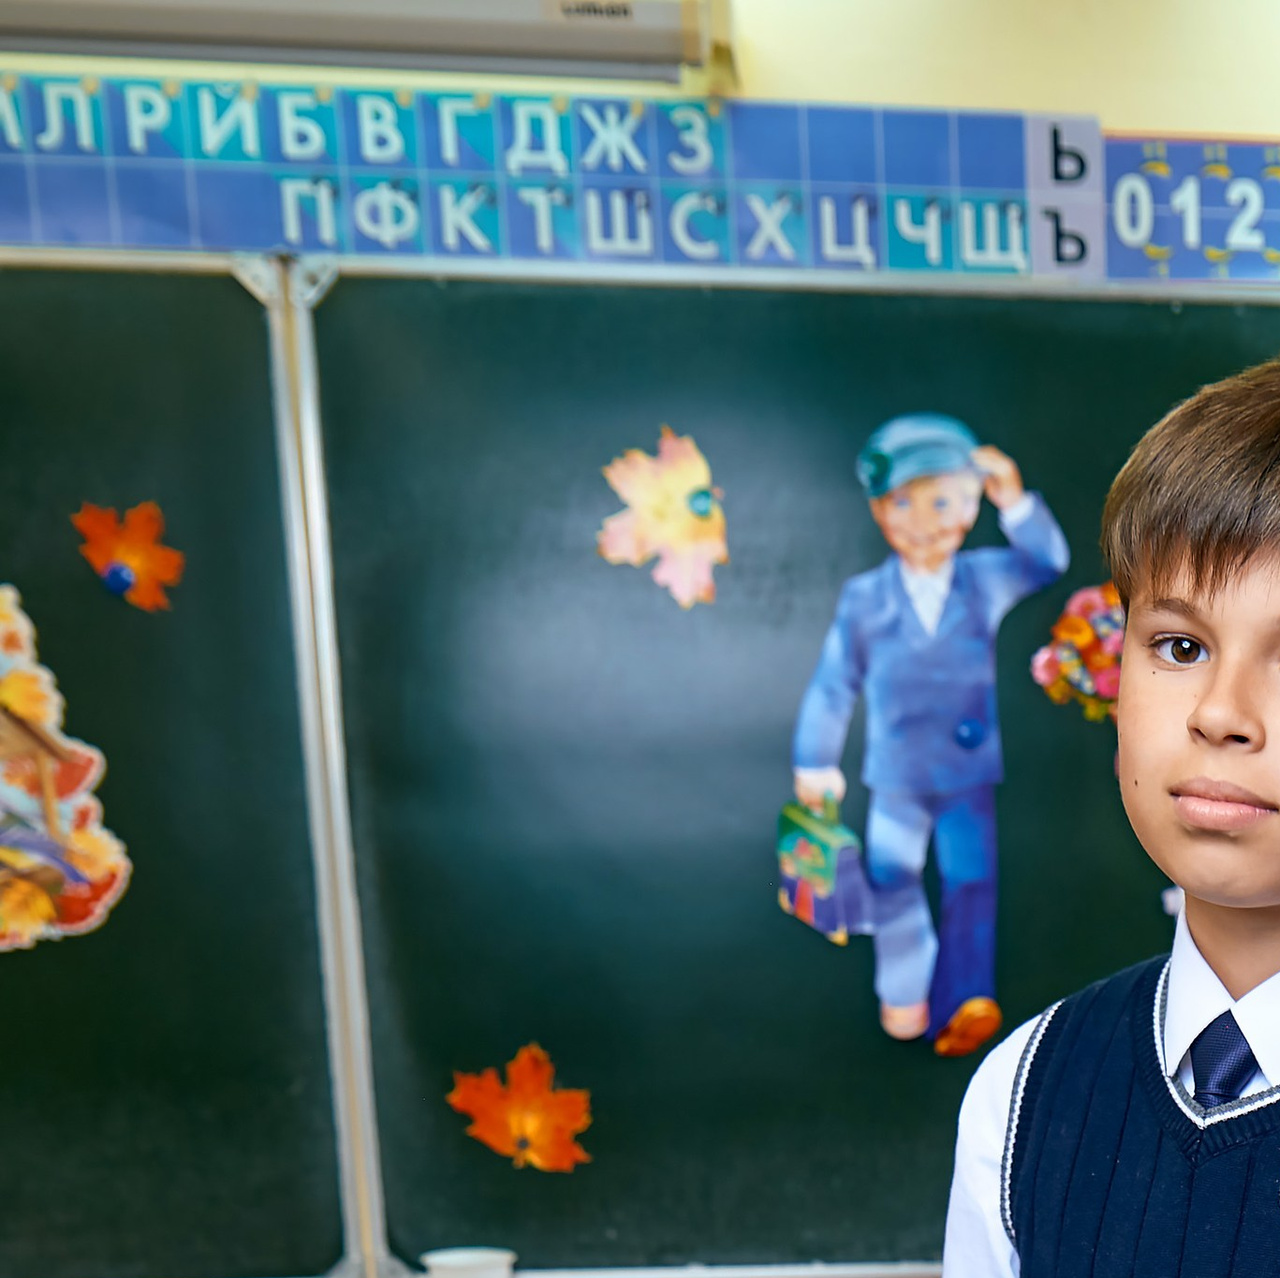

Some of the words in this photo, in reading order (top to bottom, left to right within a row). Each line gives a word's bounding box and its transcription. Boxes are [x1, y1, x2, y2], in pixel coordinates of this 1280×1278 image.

[36, 82, 96, 151] Л
[124, 84, 172, 154] Р
[197, 82, 262, 158] Й
[278, 91, 327, 161] Б
[356, 94, 404, 165] В
[438, 96, 482, 167] Г
[505, 100, 570, 178] Д
[579, 102, 648, 174] Ж
[668, 105, 712, 174] З
[1048, 123, 1087, 184] Ь
[280, 179, 337, 247] П
[352, 183, 420, 252] Ф
[438, 185, 493, 254] К
[516, 187, 565, 255] Т
[585, 188, 654, 257] Ш
[668, 192, 718, 260] С
[745, 196, 796, 262] Х
[820, 196, 875, 271] Ц
[894, 197, 943, 265] Ч
[958, 201, 1028, 273] Щ
[1112, 172, 1154, 249] 0
[1168, 174, 1201, 250] 1
[1225, 177, 1265, 251] 2
